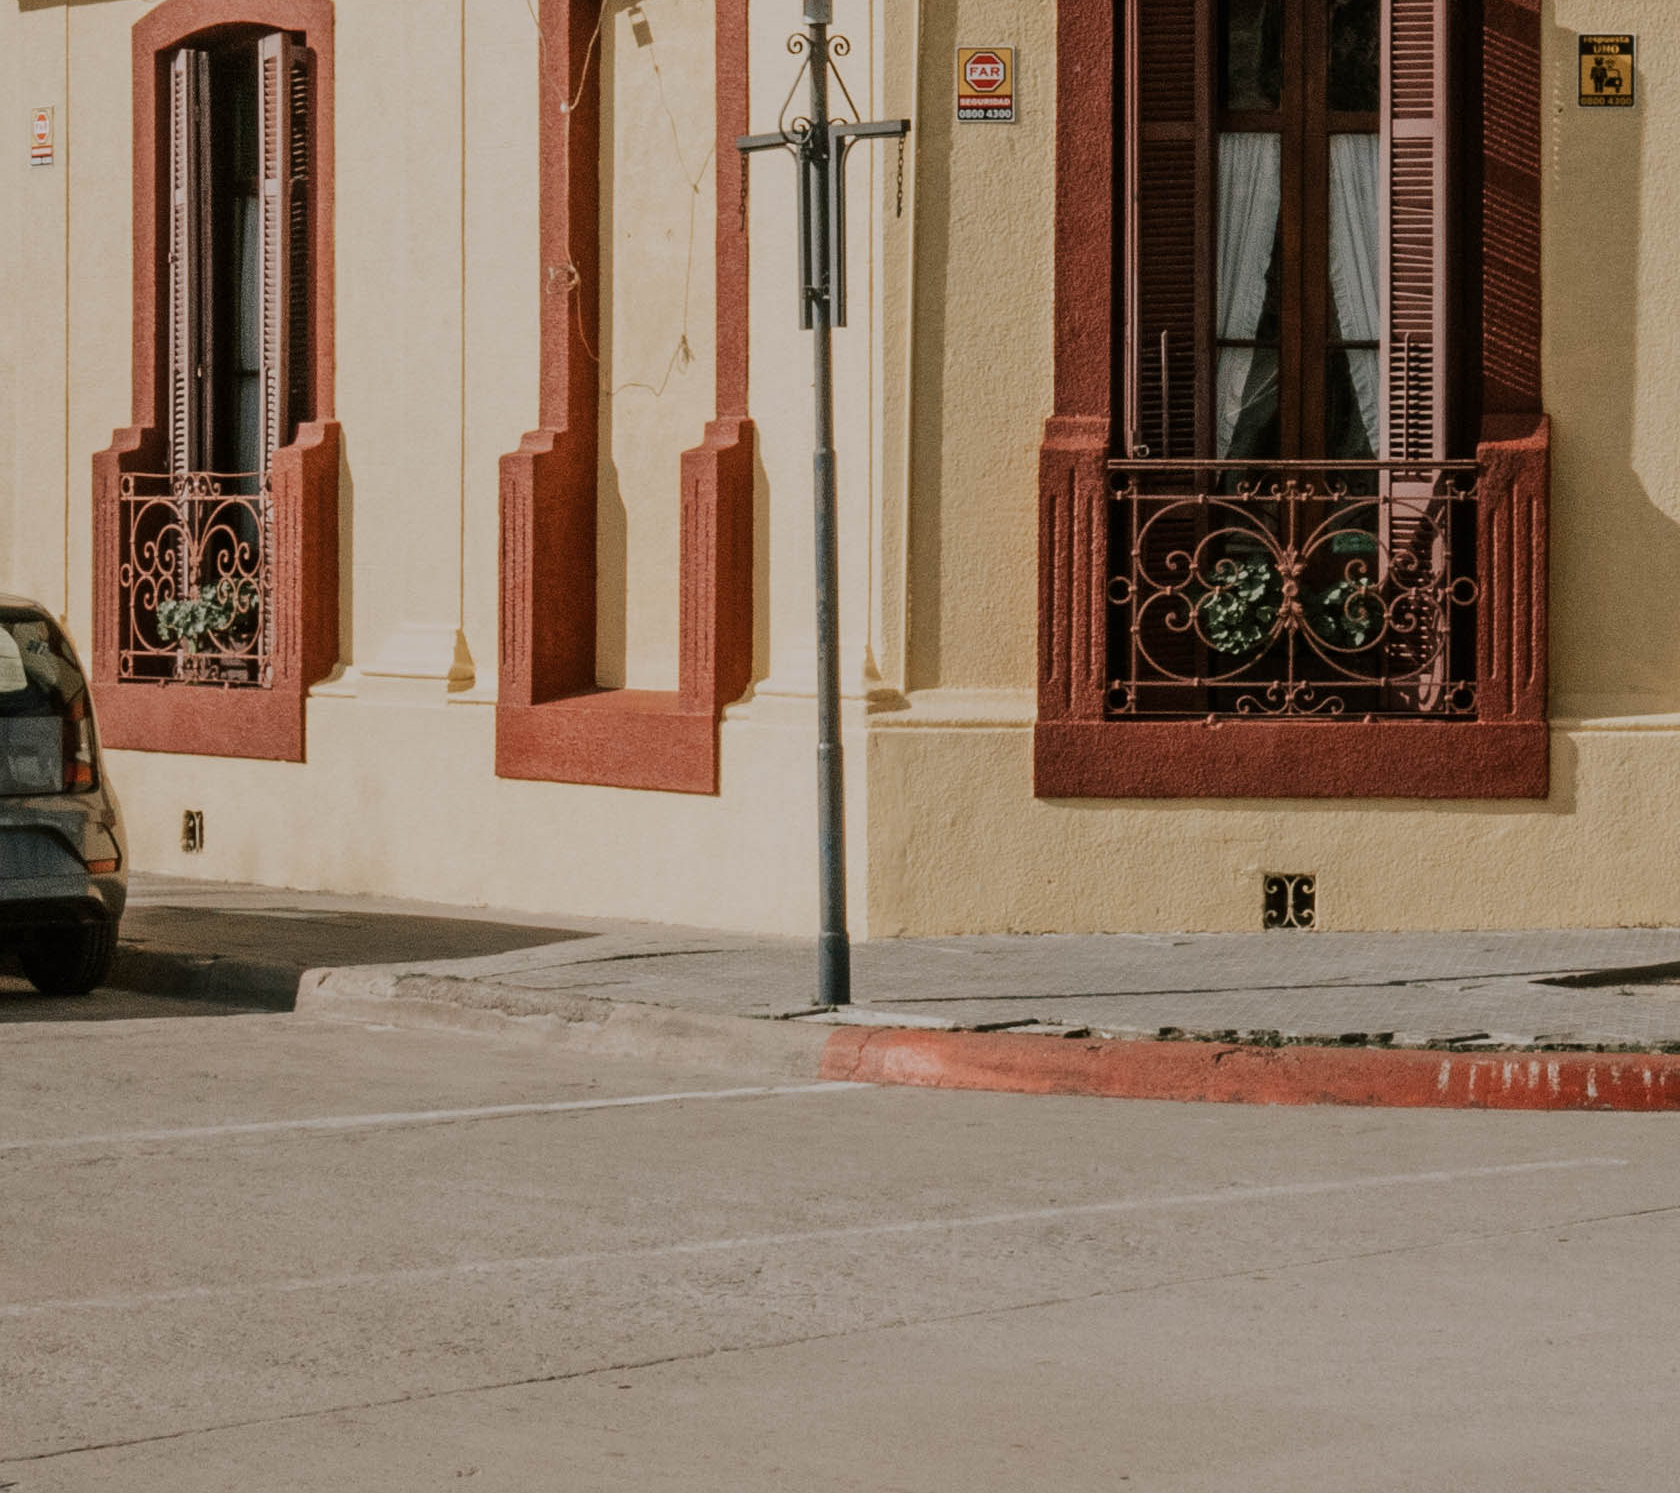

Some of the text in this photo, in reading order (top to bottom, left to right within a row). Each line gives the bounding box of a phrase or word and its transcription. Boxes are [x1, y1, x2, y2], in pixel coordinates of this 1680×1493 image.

[1593, 44, 1620, 54] UNO
[969, 66, 1001, 77] FAR
[958, 109, 1012, 119] 0800 4300
